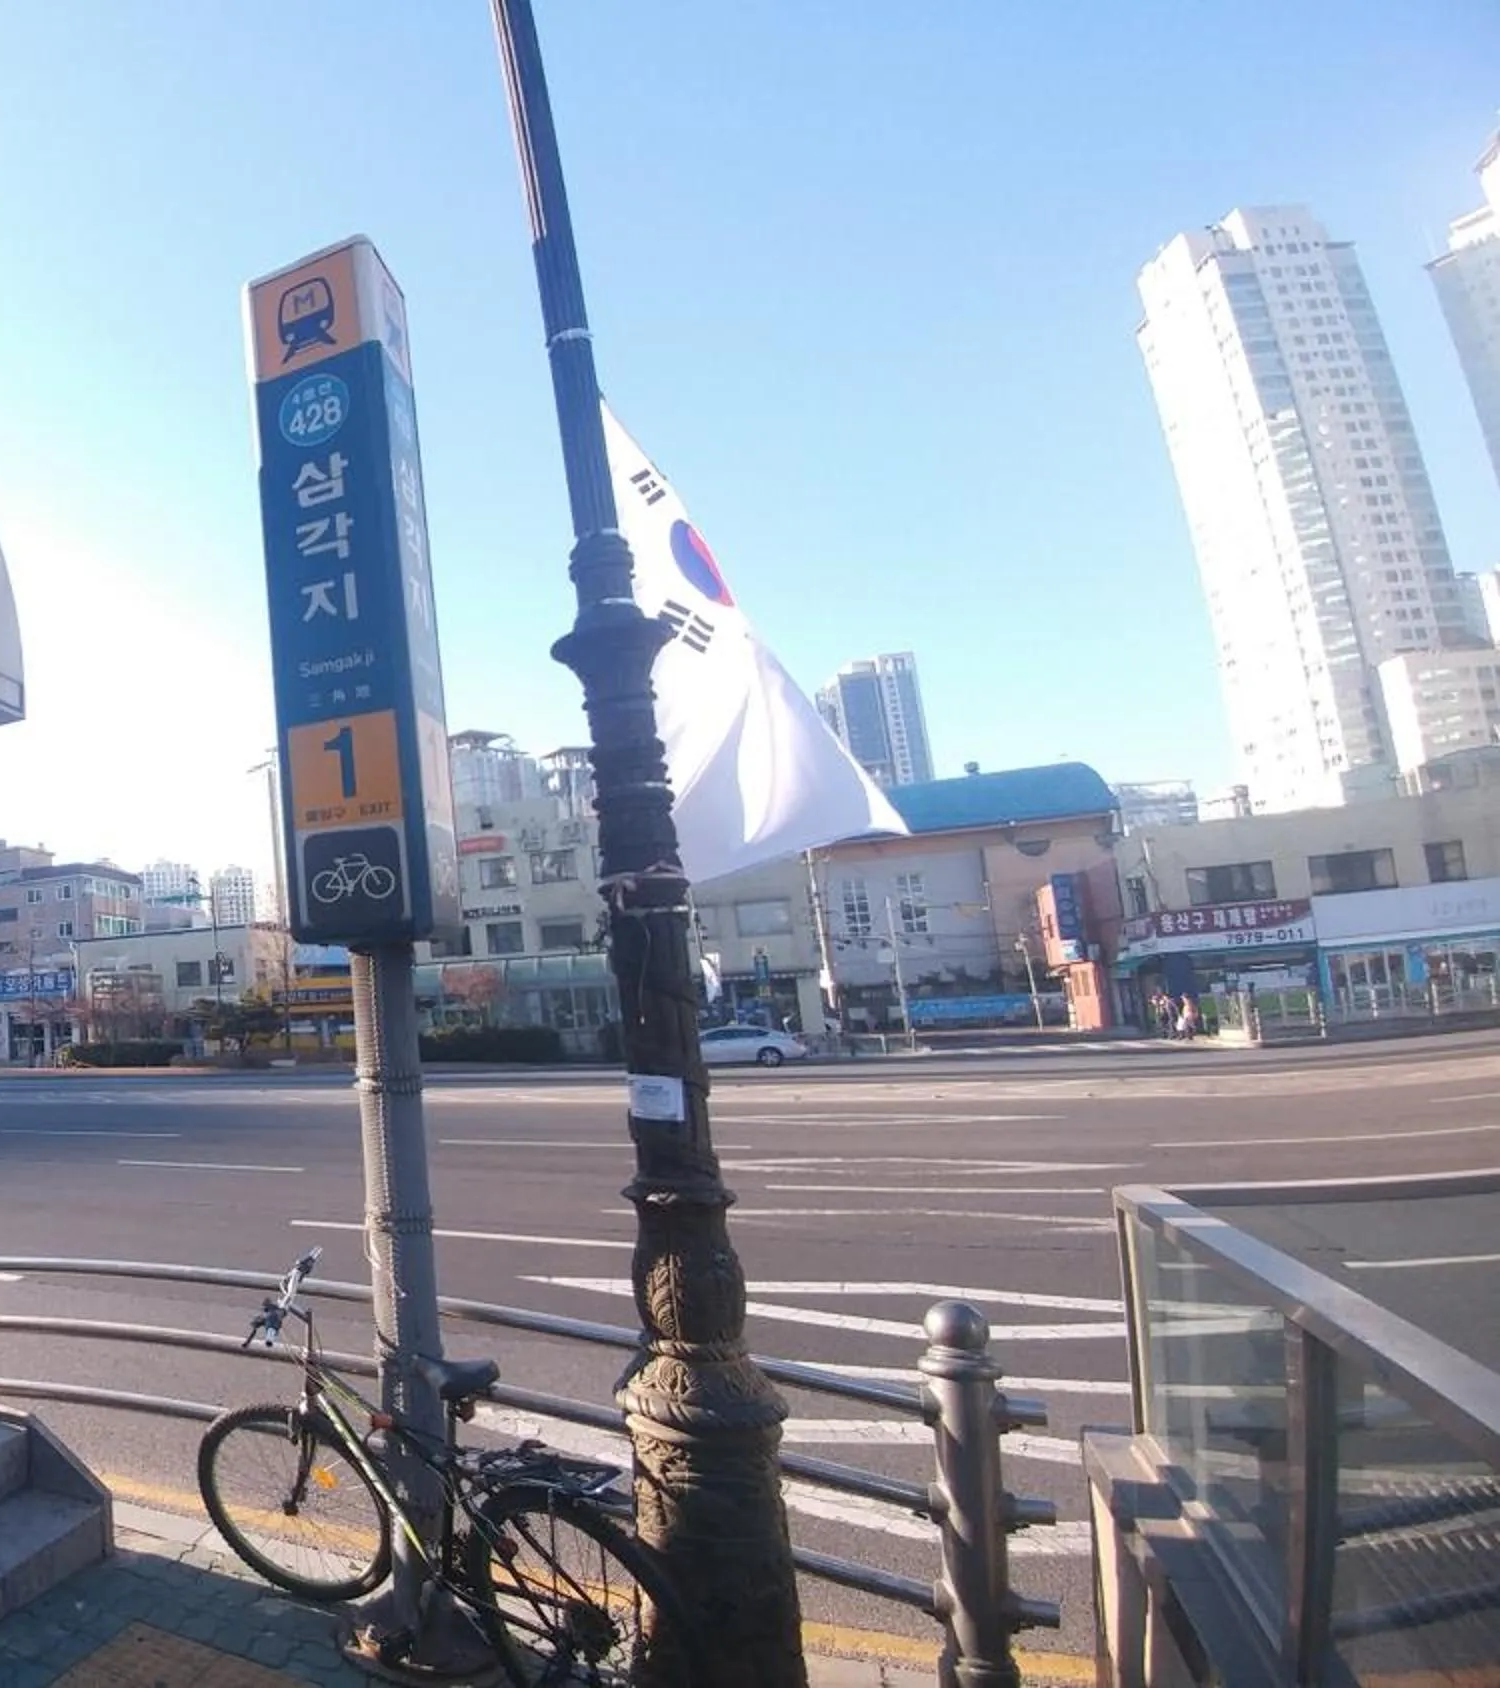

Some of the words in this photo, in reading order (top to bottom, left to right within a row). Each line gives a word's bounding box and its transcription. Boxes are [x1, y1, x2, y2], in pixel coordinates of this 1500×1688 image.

[289, 395, 342, 436] 428
[291, 451, 361, 621] 삼각지
[299, 650, 375, 678] Samgakji
[323, 726, 356, 799] 1
[1160, 912, 1205, 933] 용산구
